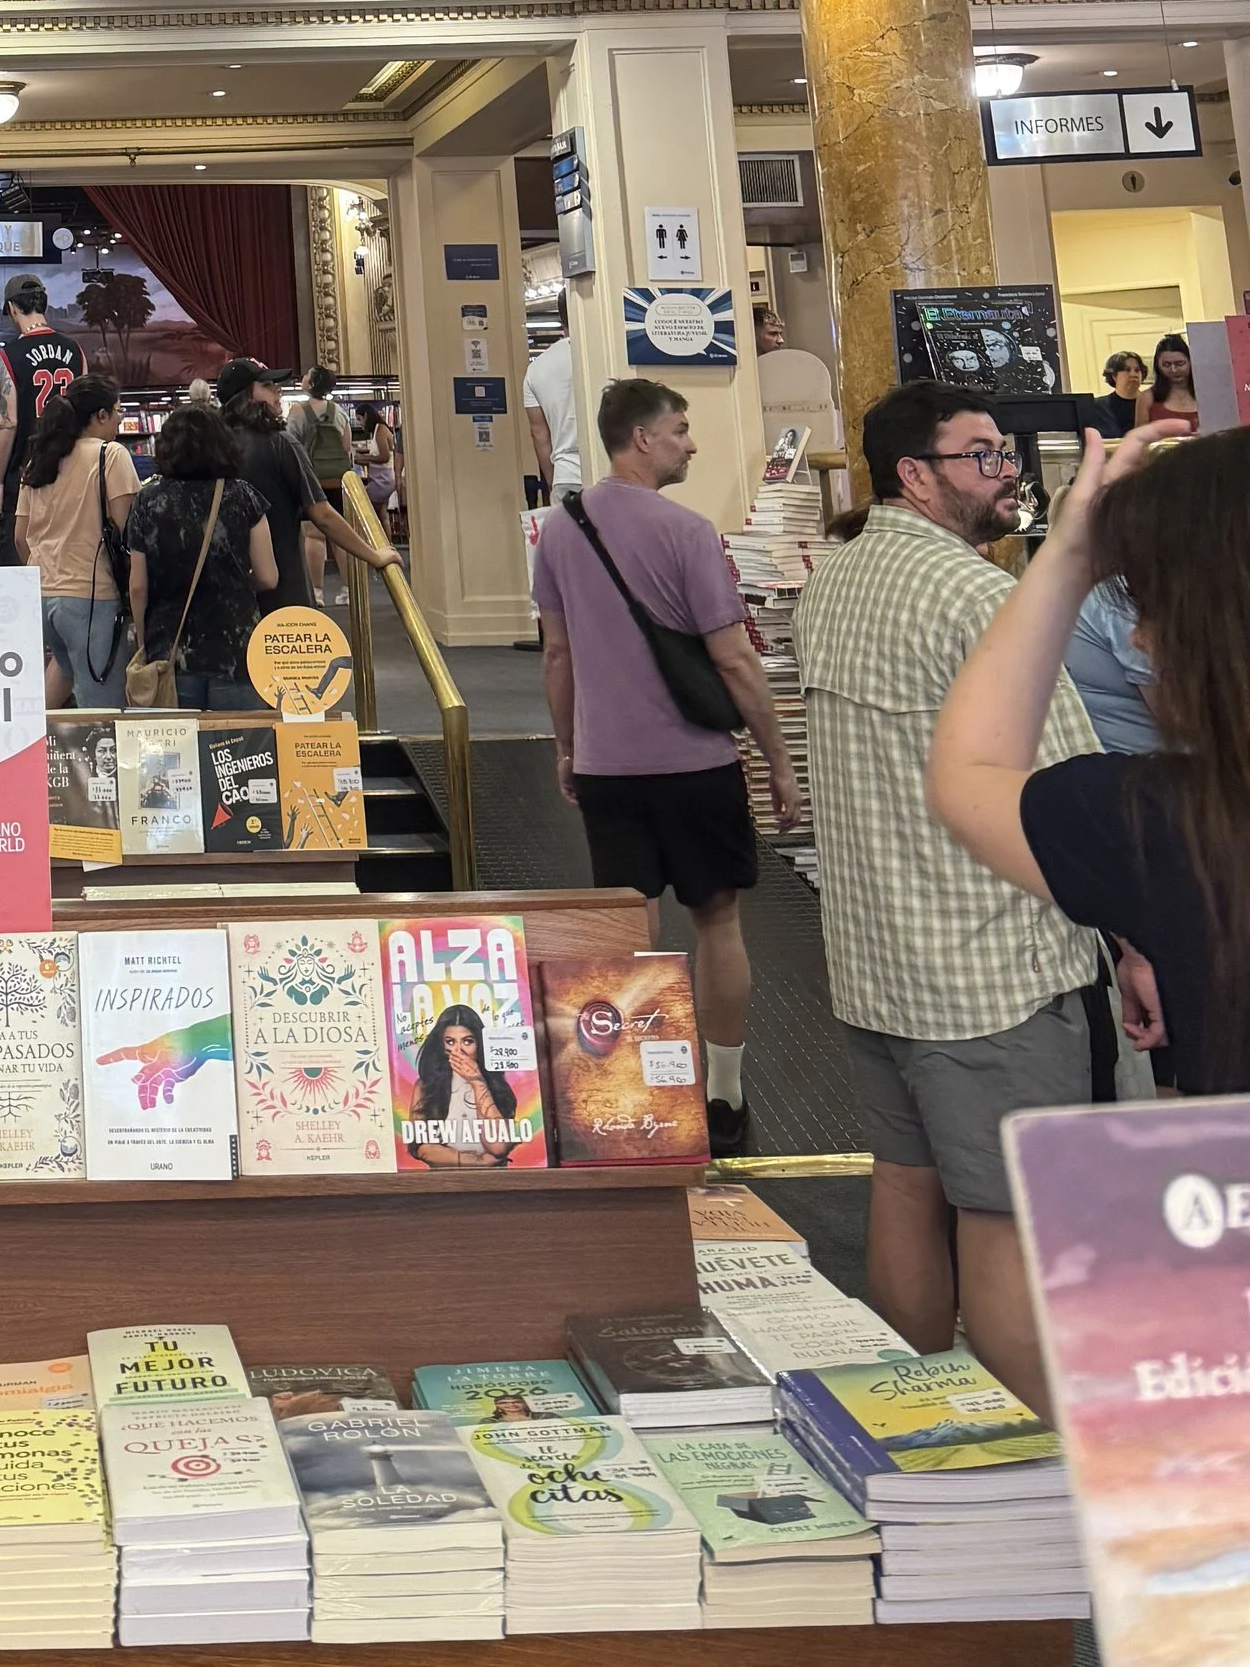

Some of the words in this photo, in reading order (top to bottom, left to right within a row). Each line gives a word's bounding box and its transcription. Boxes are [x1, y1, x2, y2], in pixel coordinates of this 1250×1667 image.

[1014, 114, 1104, 135] INFORMES
[5, 225, 12, 235] Y
[26, 344, 73, 366] JORDAN
[33, 369, 73, 418] 23
[264, 634, 312, 643] PATEAR
[316, 633, 331, 642] LA
[265, 645, 332, 654] ESCALERA
[127, 728, 187, 737] MAURICIO
[211, 748, 232, 765] LOS
[60, 763, 68, 773] la
[214, 752, 273, 778] INGENIEROS
[218, 778, 238, 791] DEL
[131, 815, 191, 825] FRANCO
[124, 956, 145, 966] MATT
[147, 956, 181, 965] RICHTEL
[389, 928, 517, 982] ALZA
[95, 987, 214, 1012] INSPIRADOS
[273, 1011, 350, 1024] DESCUBRIR
[591, 1009, 669, 1035] Secret
[9, 1032, 16, 1040] A
[18, 1030, 38, 1039] TUS
[254, 1028, 268, 1044] A
[273, 1028, 298, 1044] LA
[304, 1026, 368, 1043] DIOSA
[21, 1064, 35, 1073] TU
[38, 1063, 64, 1072] VIDA
[296, 1121, 341, 1131] SHELLEY
[401, 1120, 456, 1144] DREW
[462, 1119, 533, 1143] AFUALO
[308, 1134, 346, 1143] KAEHR
[150, 1162, 173, 1171] URANO
[145, 1340, 179, 1353] TU
[120, 1357, 215, 1374] MEJOR
[251, 1367, 378, 1380] LUDOVICA
[116, 1375, 228, 1395] FUTURO
[869, 1376, 977, 1401] Sharma
[464, 1386, 549, 1401] 2026
[308, 1418, 430, 1432] GABRIEL
[473, 1431, 520, 1440] JOHN
[527, 1425, 613, 1437] GOTTMAN
[323, 1426, 421, 1442] ROLÓN
[658, 1452, 690, 1463] LAS
[694, 1448, 788, 1461] EMOCIONES
[382, 1485, 412, 1495] LA
[530, 1483, 625, 1504] citas
[342, 1494, 458, 1509] SOLEDAD
